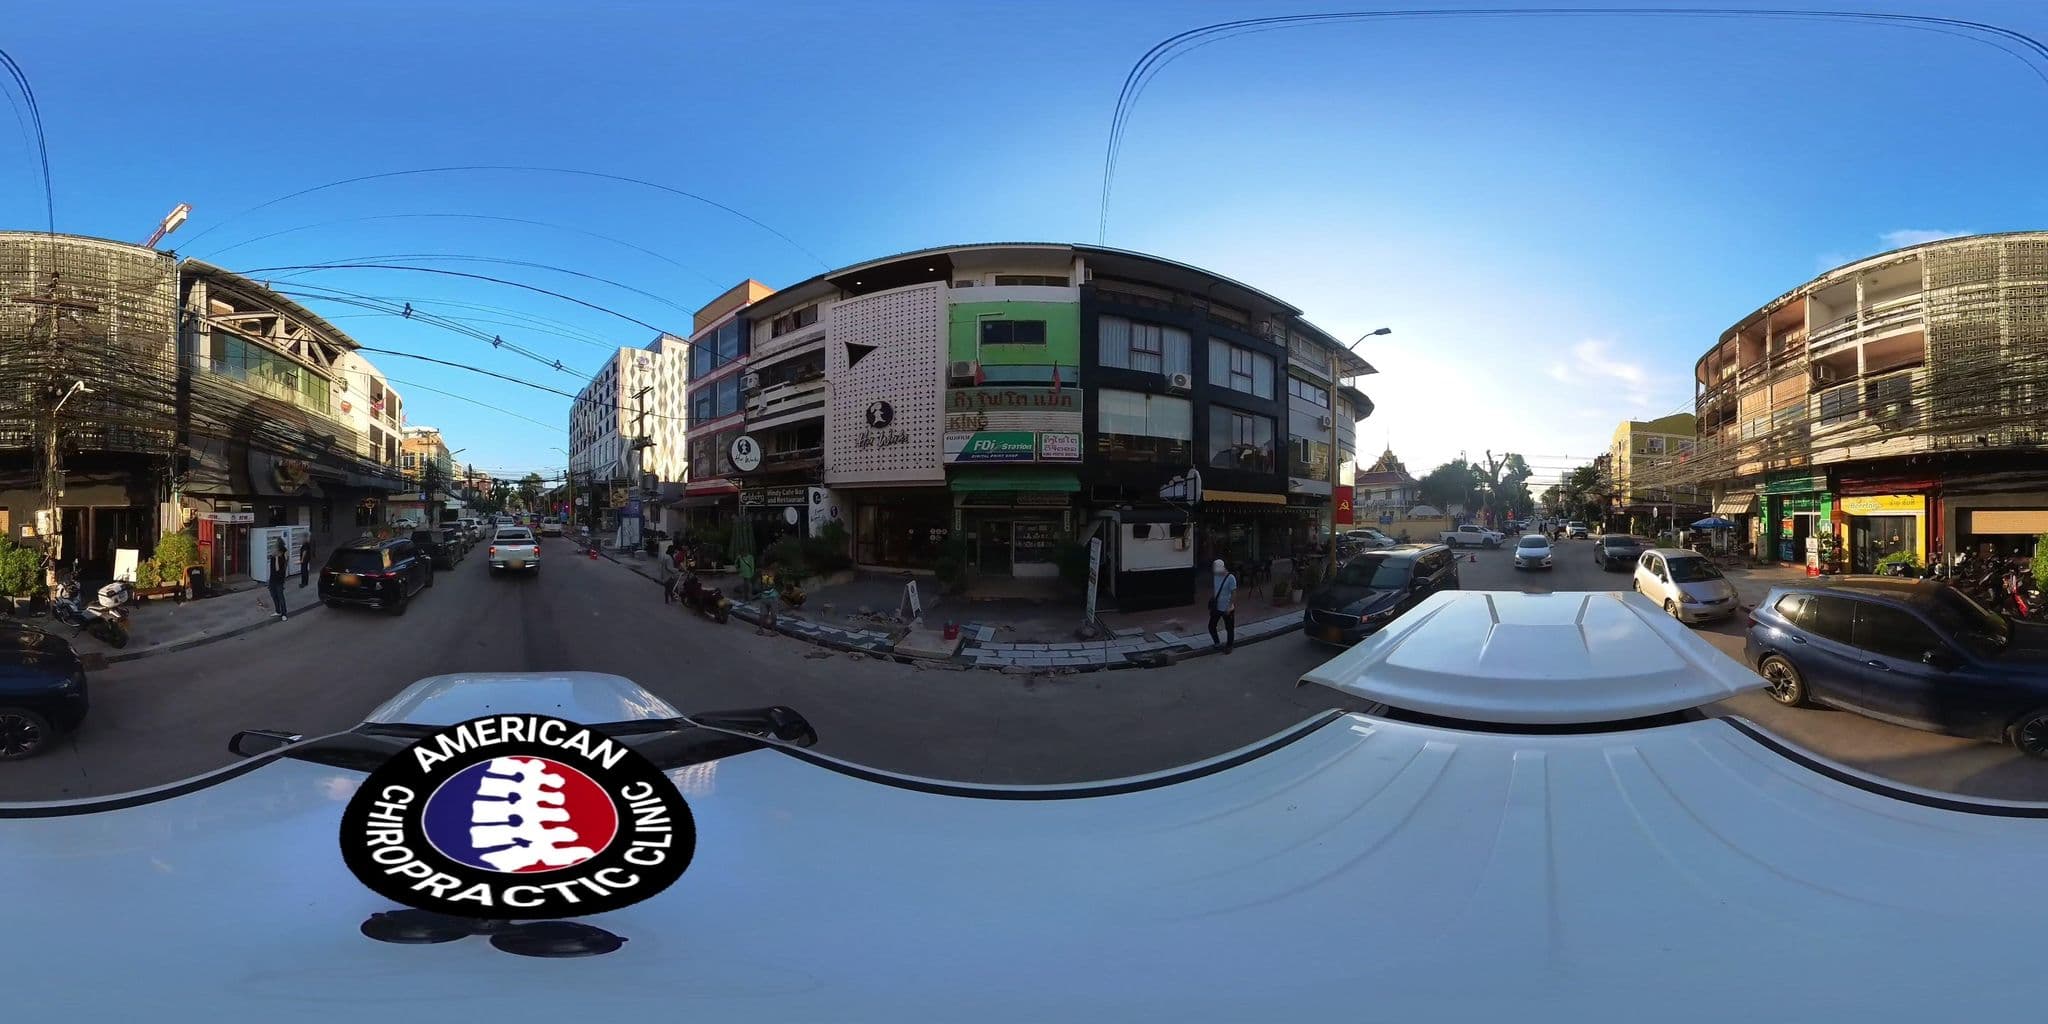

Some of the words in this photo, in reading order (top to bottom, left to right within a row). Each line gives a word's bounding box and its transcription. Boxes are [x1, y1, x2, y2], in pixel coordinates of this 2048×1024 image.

[949, 414, 988, 430] KING
[1001, 442, 1032, 451] Station
[777, 496, 805, 504] Restaurant
